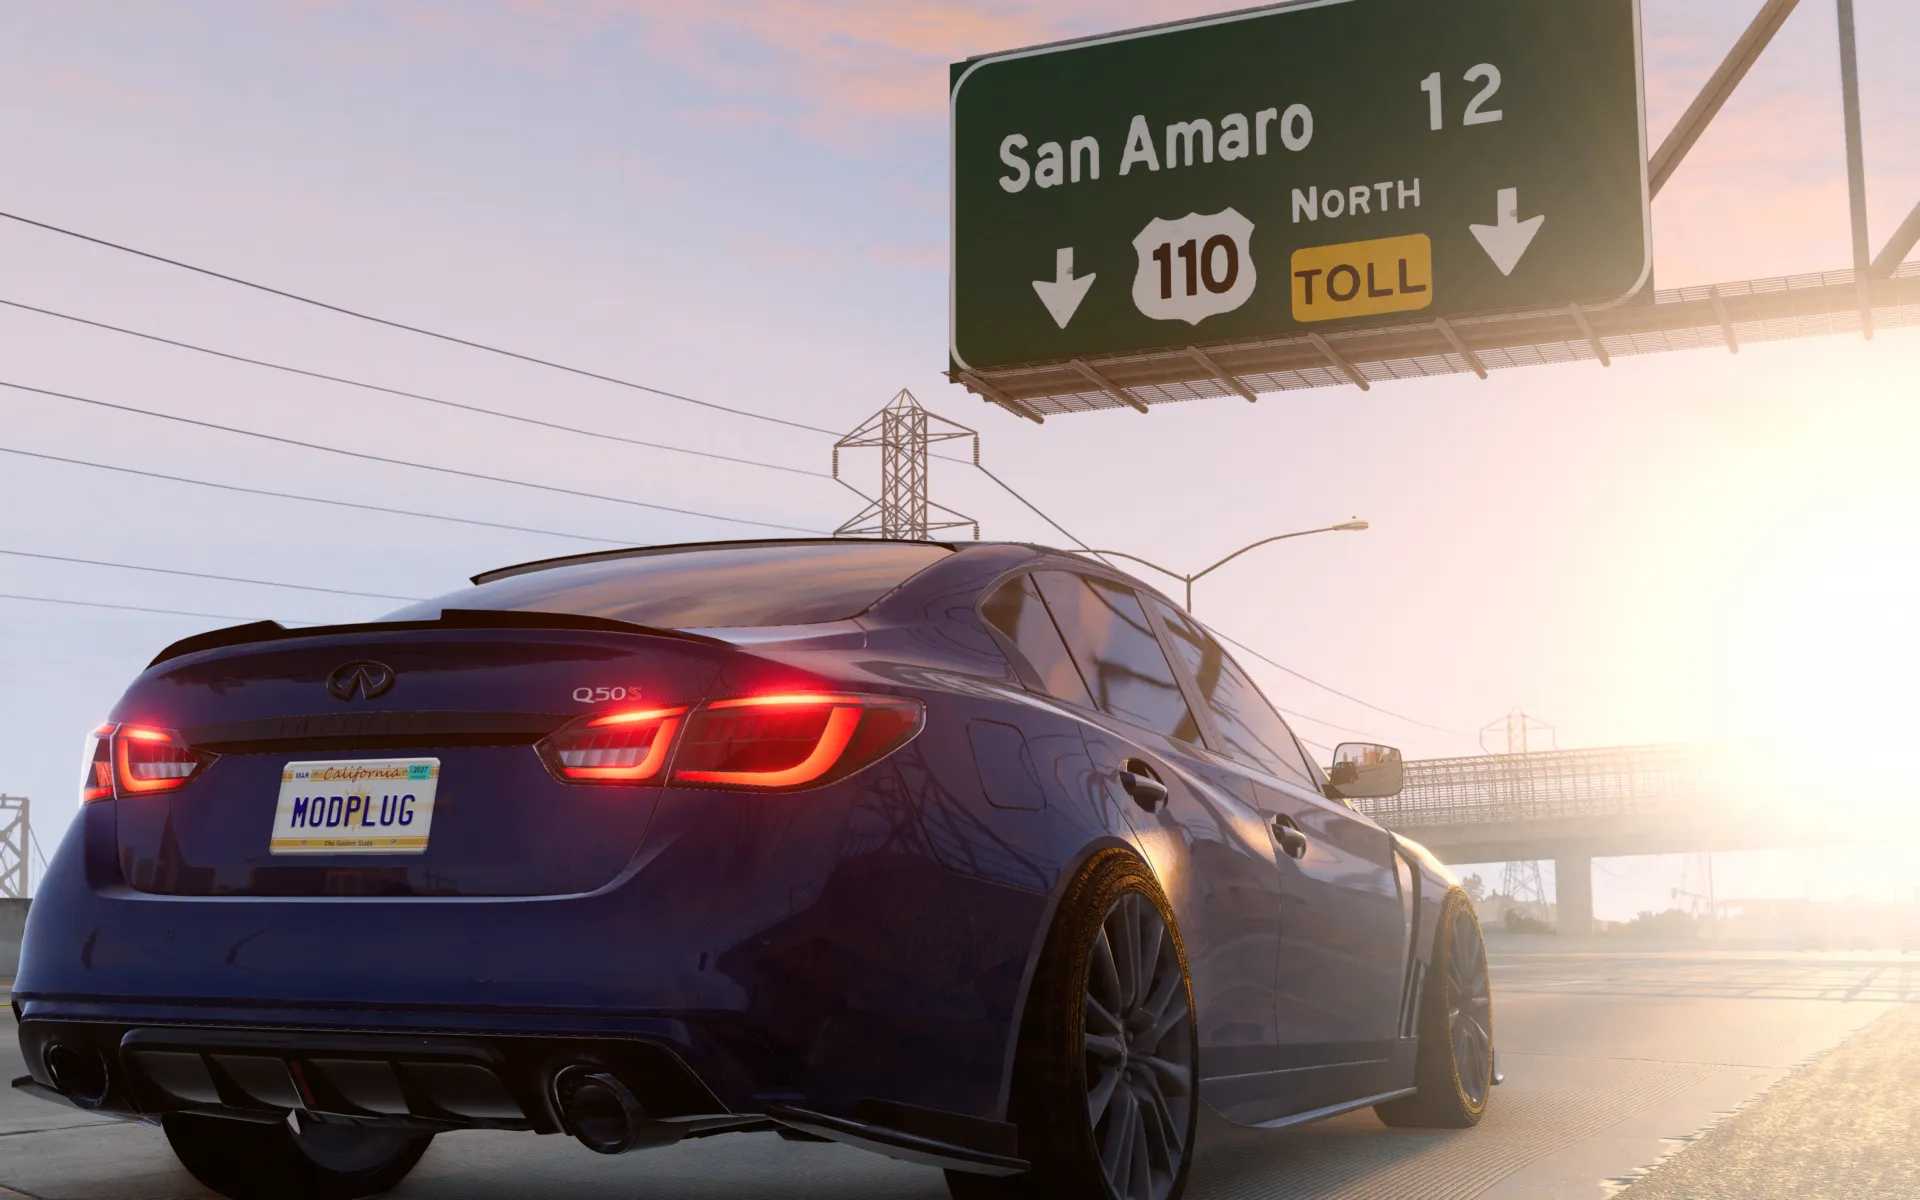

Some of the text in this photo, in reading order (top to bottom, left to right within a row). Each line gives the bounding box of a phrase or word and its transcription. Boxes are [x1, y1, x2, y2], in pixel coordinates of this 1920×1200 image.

[1420, 63, 1503, 131] 12
[999, 103, 1314, 194] San Amaro
[1291, 178, 1421, 223] NORTH
[1152, 233, 1239, 300] 110
[1294, 258, 1427, 306] TOLL
[323, 765, 401, 783] California
[413, 766, 429, 774] 2027
[291, 794, 416, 828] MODPLUG
[358, 839, 373, 847] State
